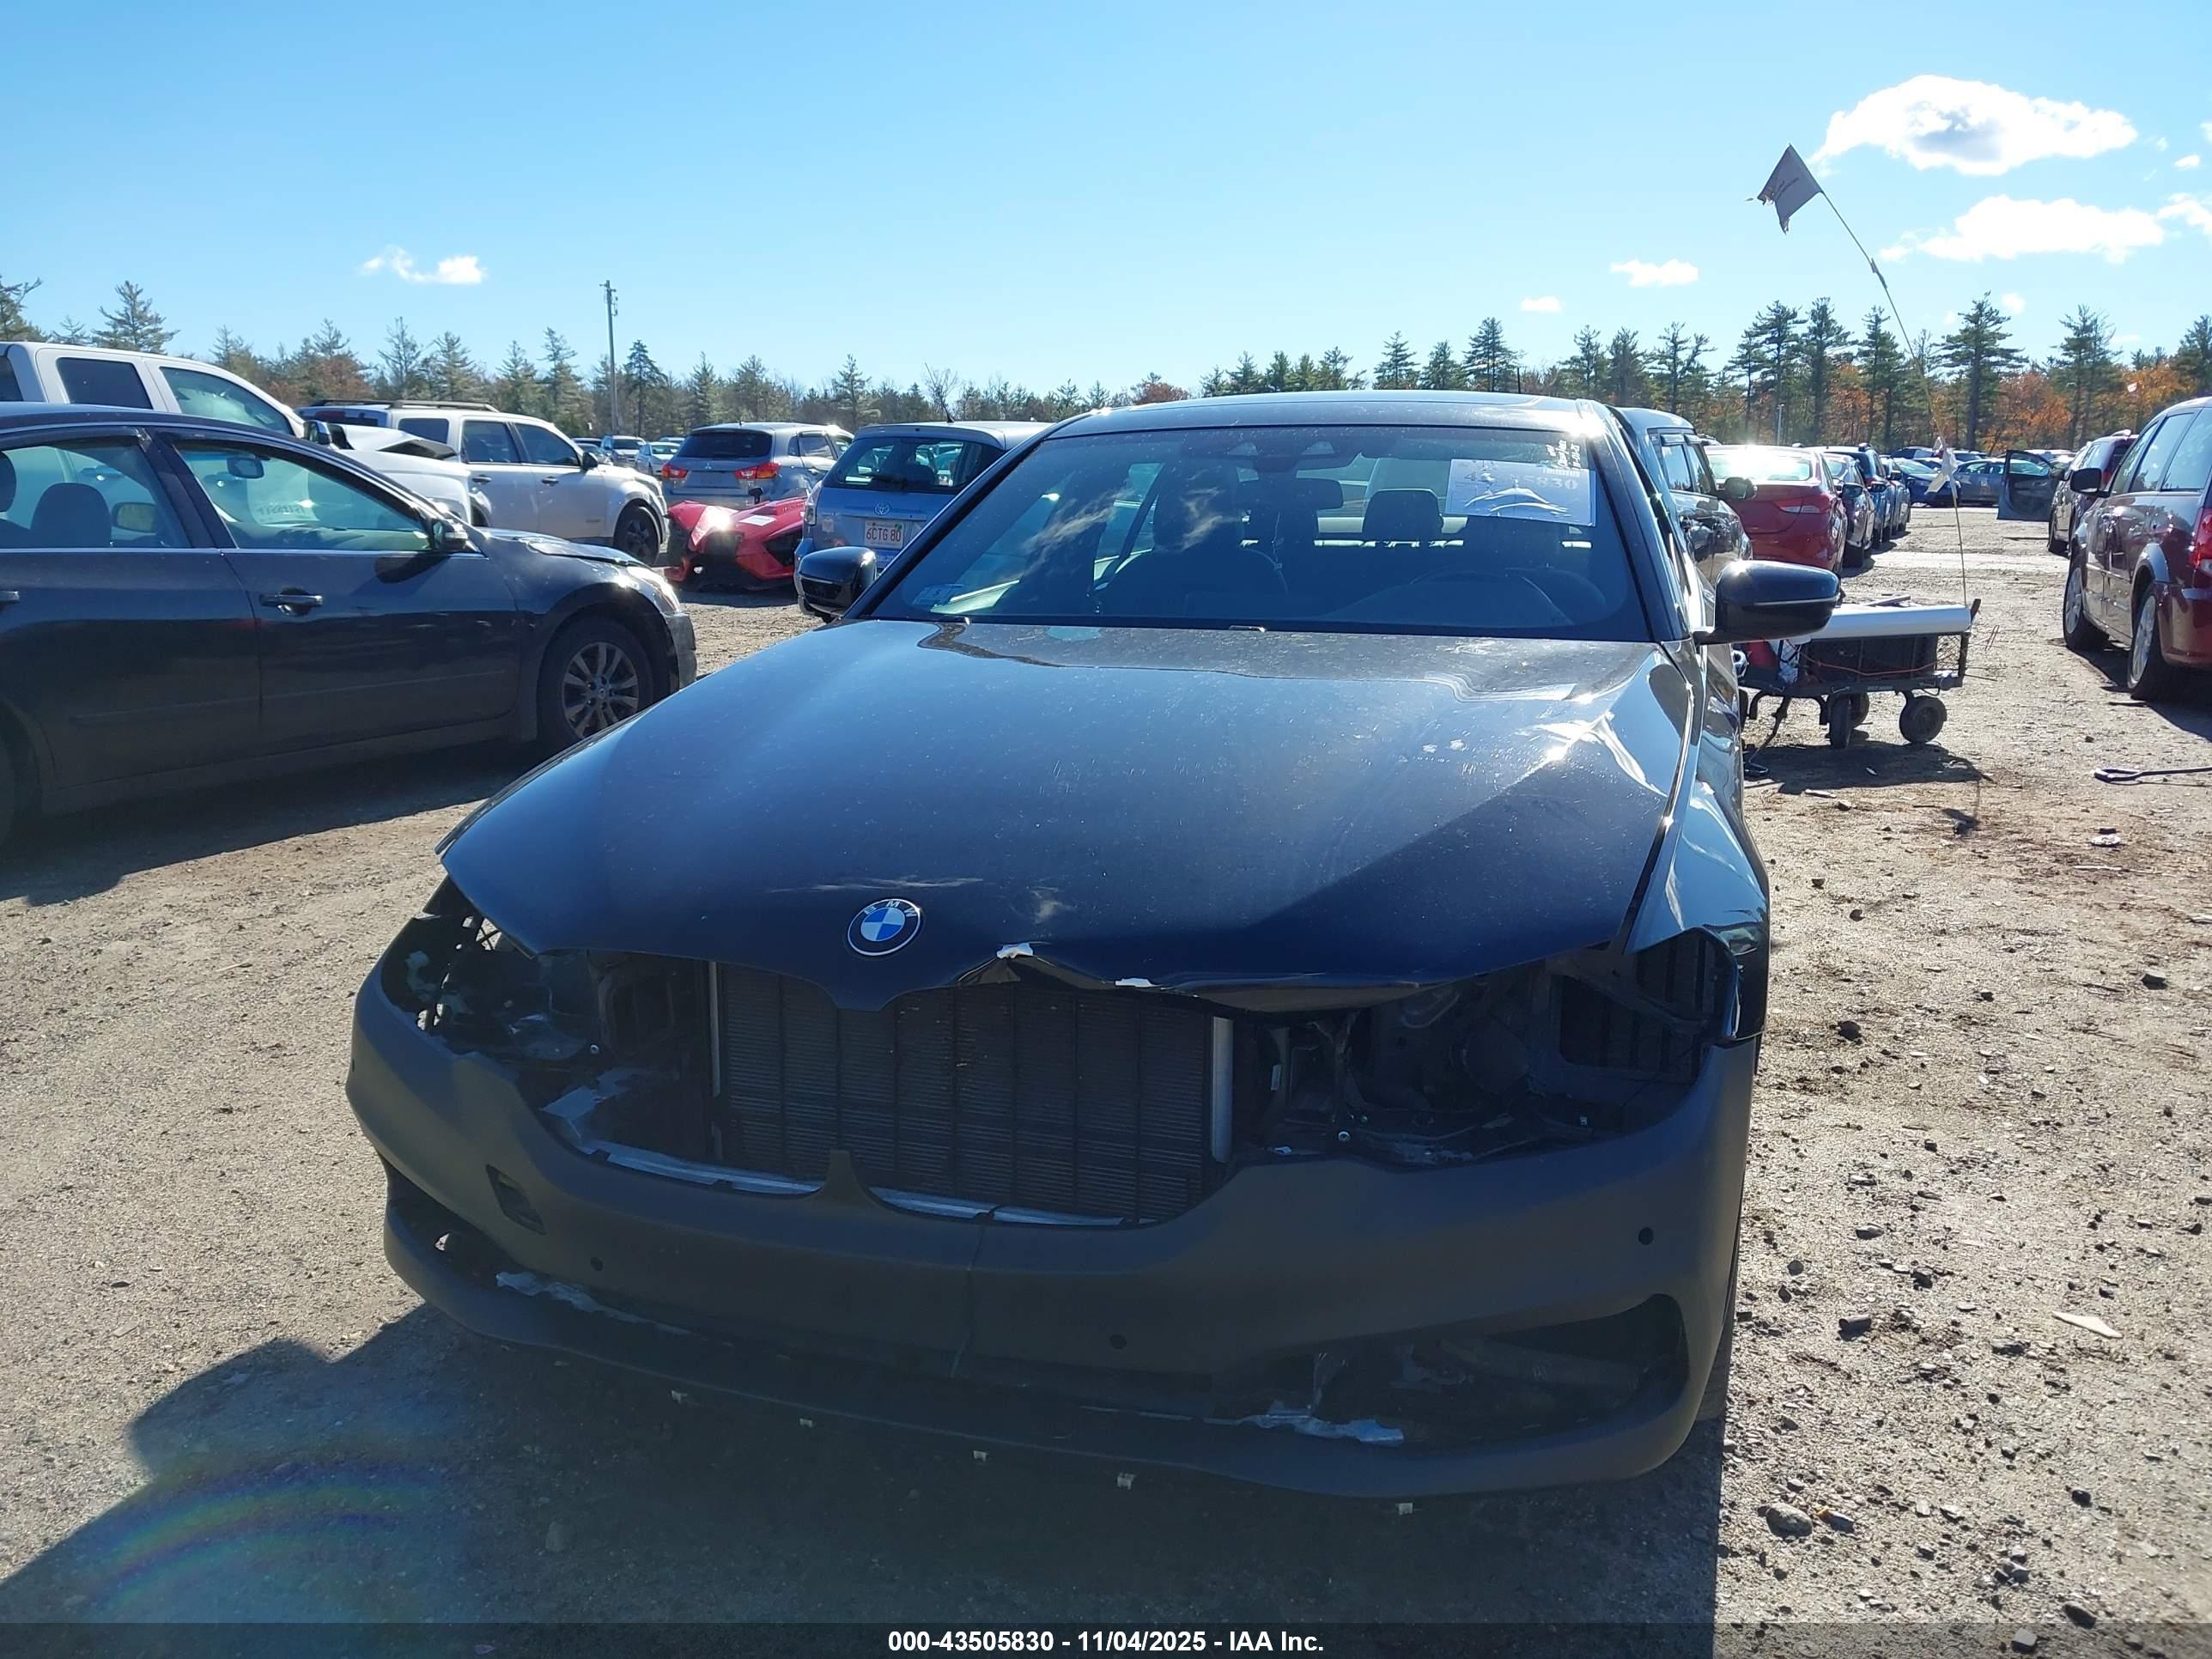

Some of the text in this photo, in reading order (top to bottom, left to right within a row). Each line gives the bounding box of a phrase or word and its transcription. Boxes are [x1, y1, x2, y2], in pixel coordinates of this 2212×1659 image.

[866, 527, 902, 543] 6CTG 80
[863, 899, 918, 918] BMW
